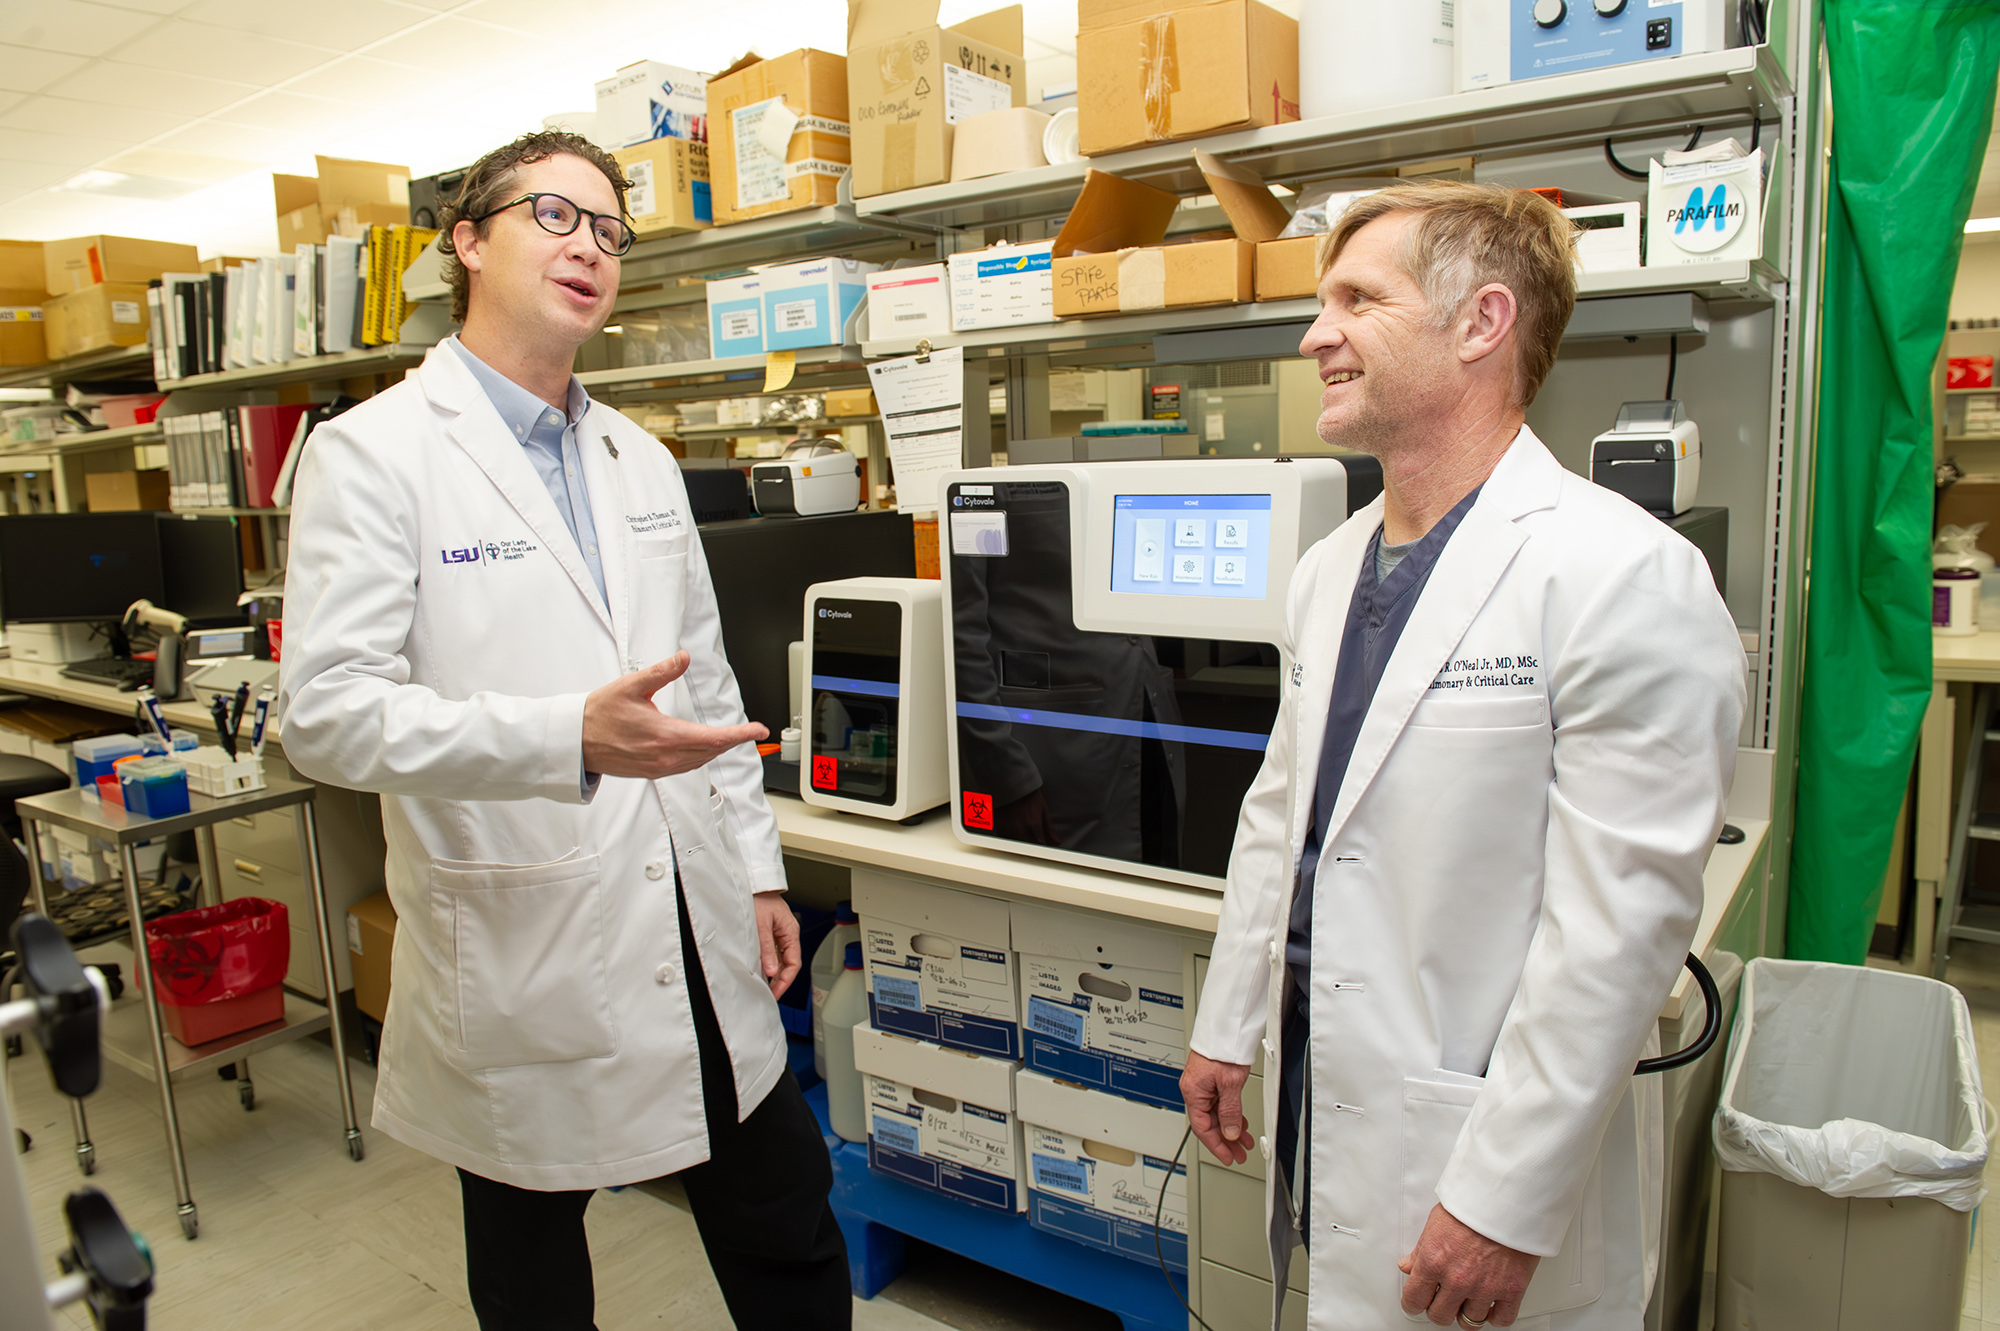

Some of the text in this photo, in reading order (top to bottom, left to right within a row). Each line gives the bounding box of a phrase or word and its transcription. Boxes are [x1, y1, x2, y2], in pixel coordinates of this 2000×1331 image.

[1667, 203, 1739, 222] PARAFILM
[799, 265, 828, 277] eppendorf
[883, 364, 909, 374] Cytovale
[963, 497, 995, 507] Cytovale
[441, 547, 480, 563] LSU
[504, 553, 525, 561] Health
[827, 609, 853, 619] Cytovale
[1453, 658, 1479, 672] O'Neal
[1481, 658, 1493, 671] Jr,
[1495, 657, 1515, 670] MD,
[1517, 656, 1538, 668] MSc
[1465, 676, 1473, 687] &
[1474, 673, 1509, 687] Critical
[1511, 673, 1534, 685] Care
[875, 938, 894, 946] LISTED
[876, 947, 896, 955] IMAGED
[962, 949, 988, 958] CUSTOMER
[1039, 972, 1059, 981] LISTED
[1039, 982, 1062, 992] IMAGED
[1141, 990, 1171, 1002] CUSTOMER
[877, 1083, 896, 1093] LISTED
[878, 1092, 898, 1102] IMAGED
[1042, 1134, 1063, 1144] LISTED
[1042, 1143, 1066, 1154] IMAGED
